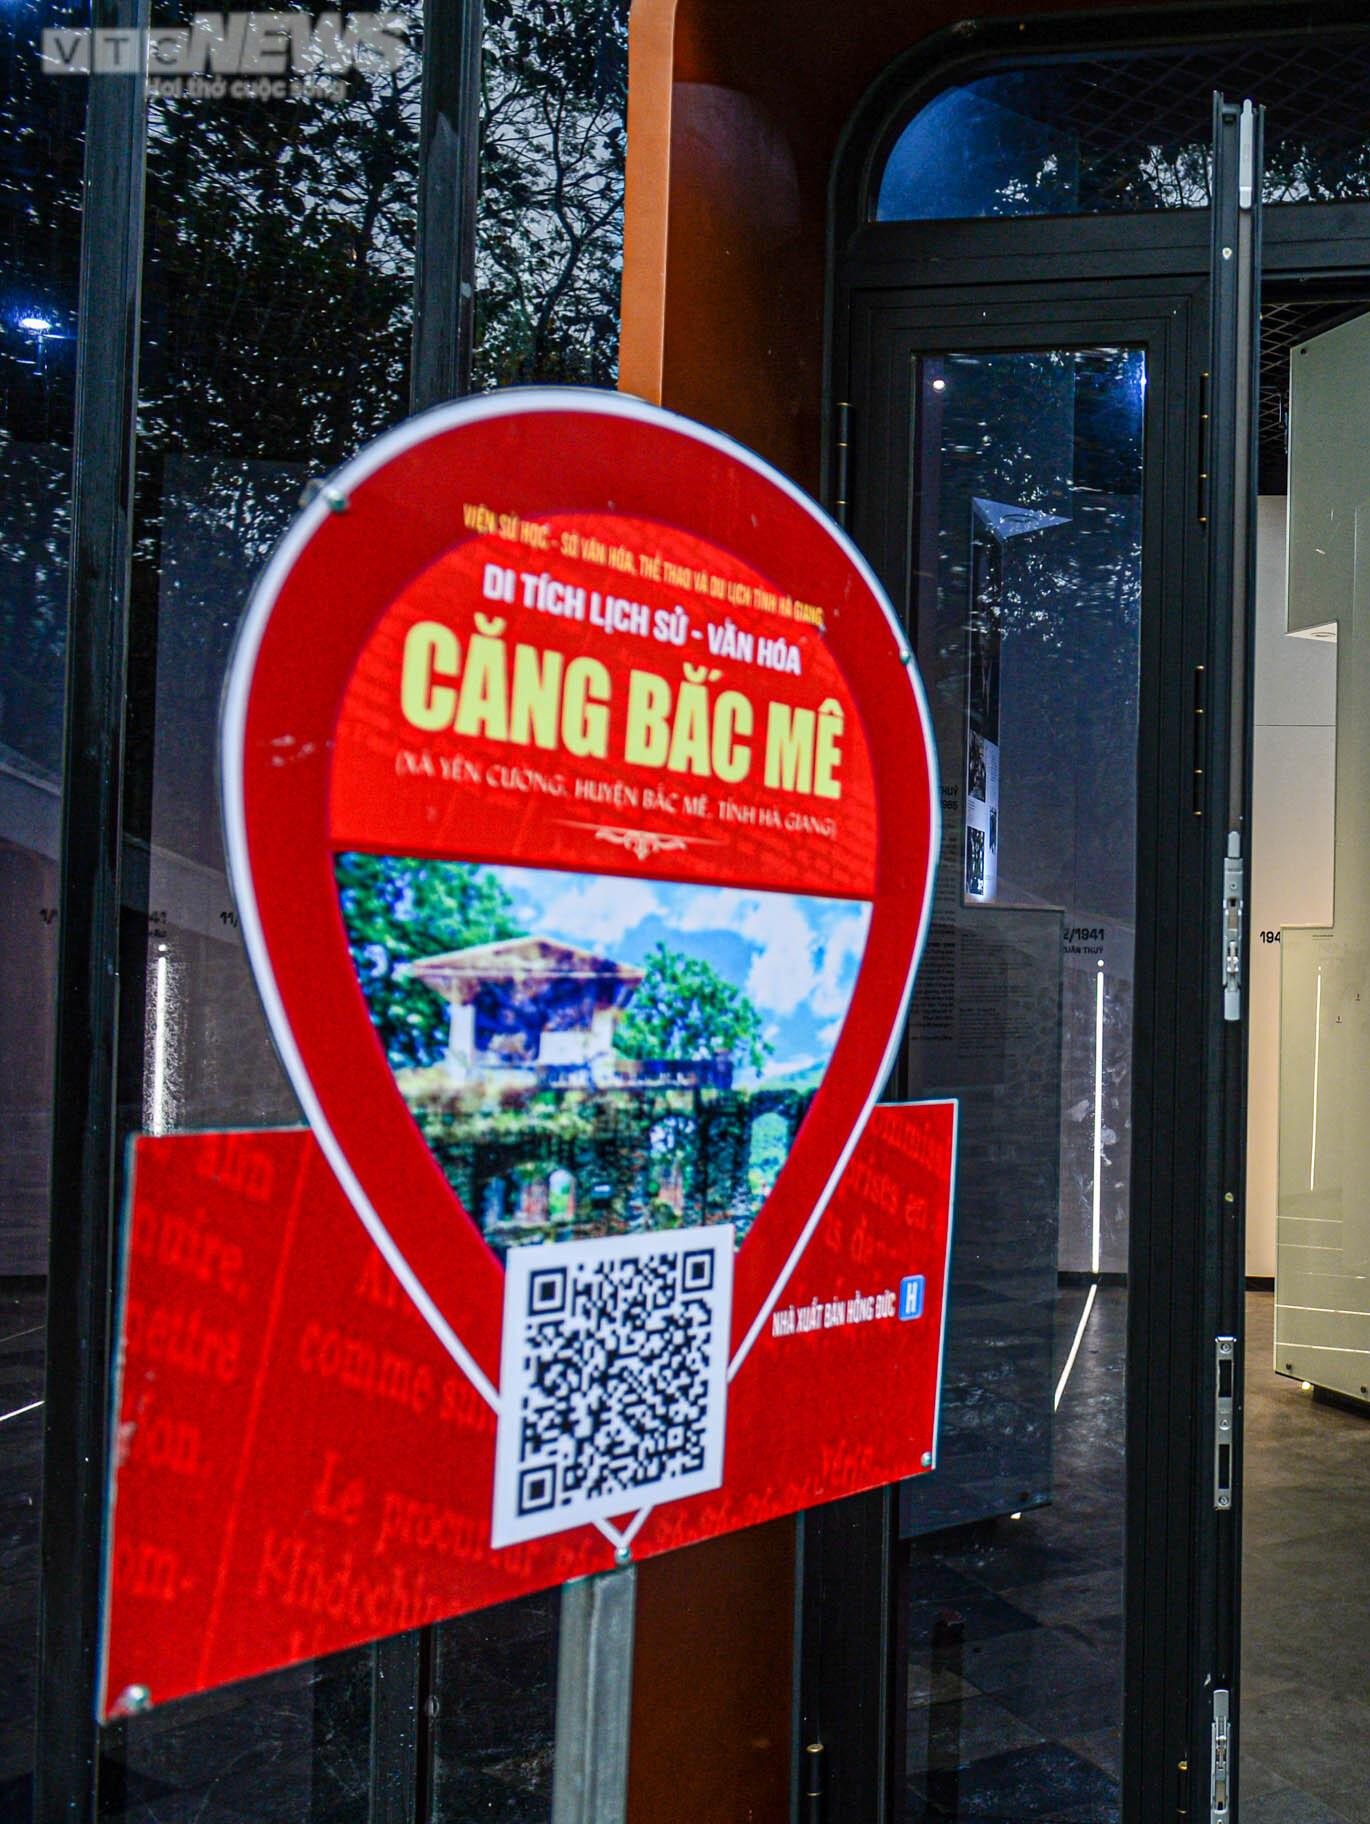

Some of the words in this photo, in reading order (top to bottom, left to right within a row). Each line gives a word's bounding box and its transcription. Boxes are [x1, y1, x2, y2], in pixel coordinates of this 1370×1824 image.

[463, 502, 497, 535] VIỆN
[520, 520, 549, 551] HỌC
[663, 560, 692, 590] THAO
[710, 575, 726, 600] DU
[727, 581, 752, 606] LỊCH
[483, 562, 516, 604] DI
[520, 571, 587, 621] TÍCH
[589, 591, 650, 638] LỊCH
[653, 604, 689, 646] SỬ
[707, 617, 754, 663] VĂN
[757, 636, 802, 676] HÓA
[400, 611, 612, 759] CĂNG
[625, 661, 753, 783] BẮC
[764, 698, 846, 800] MÊ
[772, 1305, 796, 1338] NHÀ
[796, 1296, 824, 1333] XUẤT
[824, 1296, 846, 1328] BẢN
[846, 1289, 875, 1324] HỒNG
[875, 1288, 897, 1319] ĐỨC
